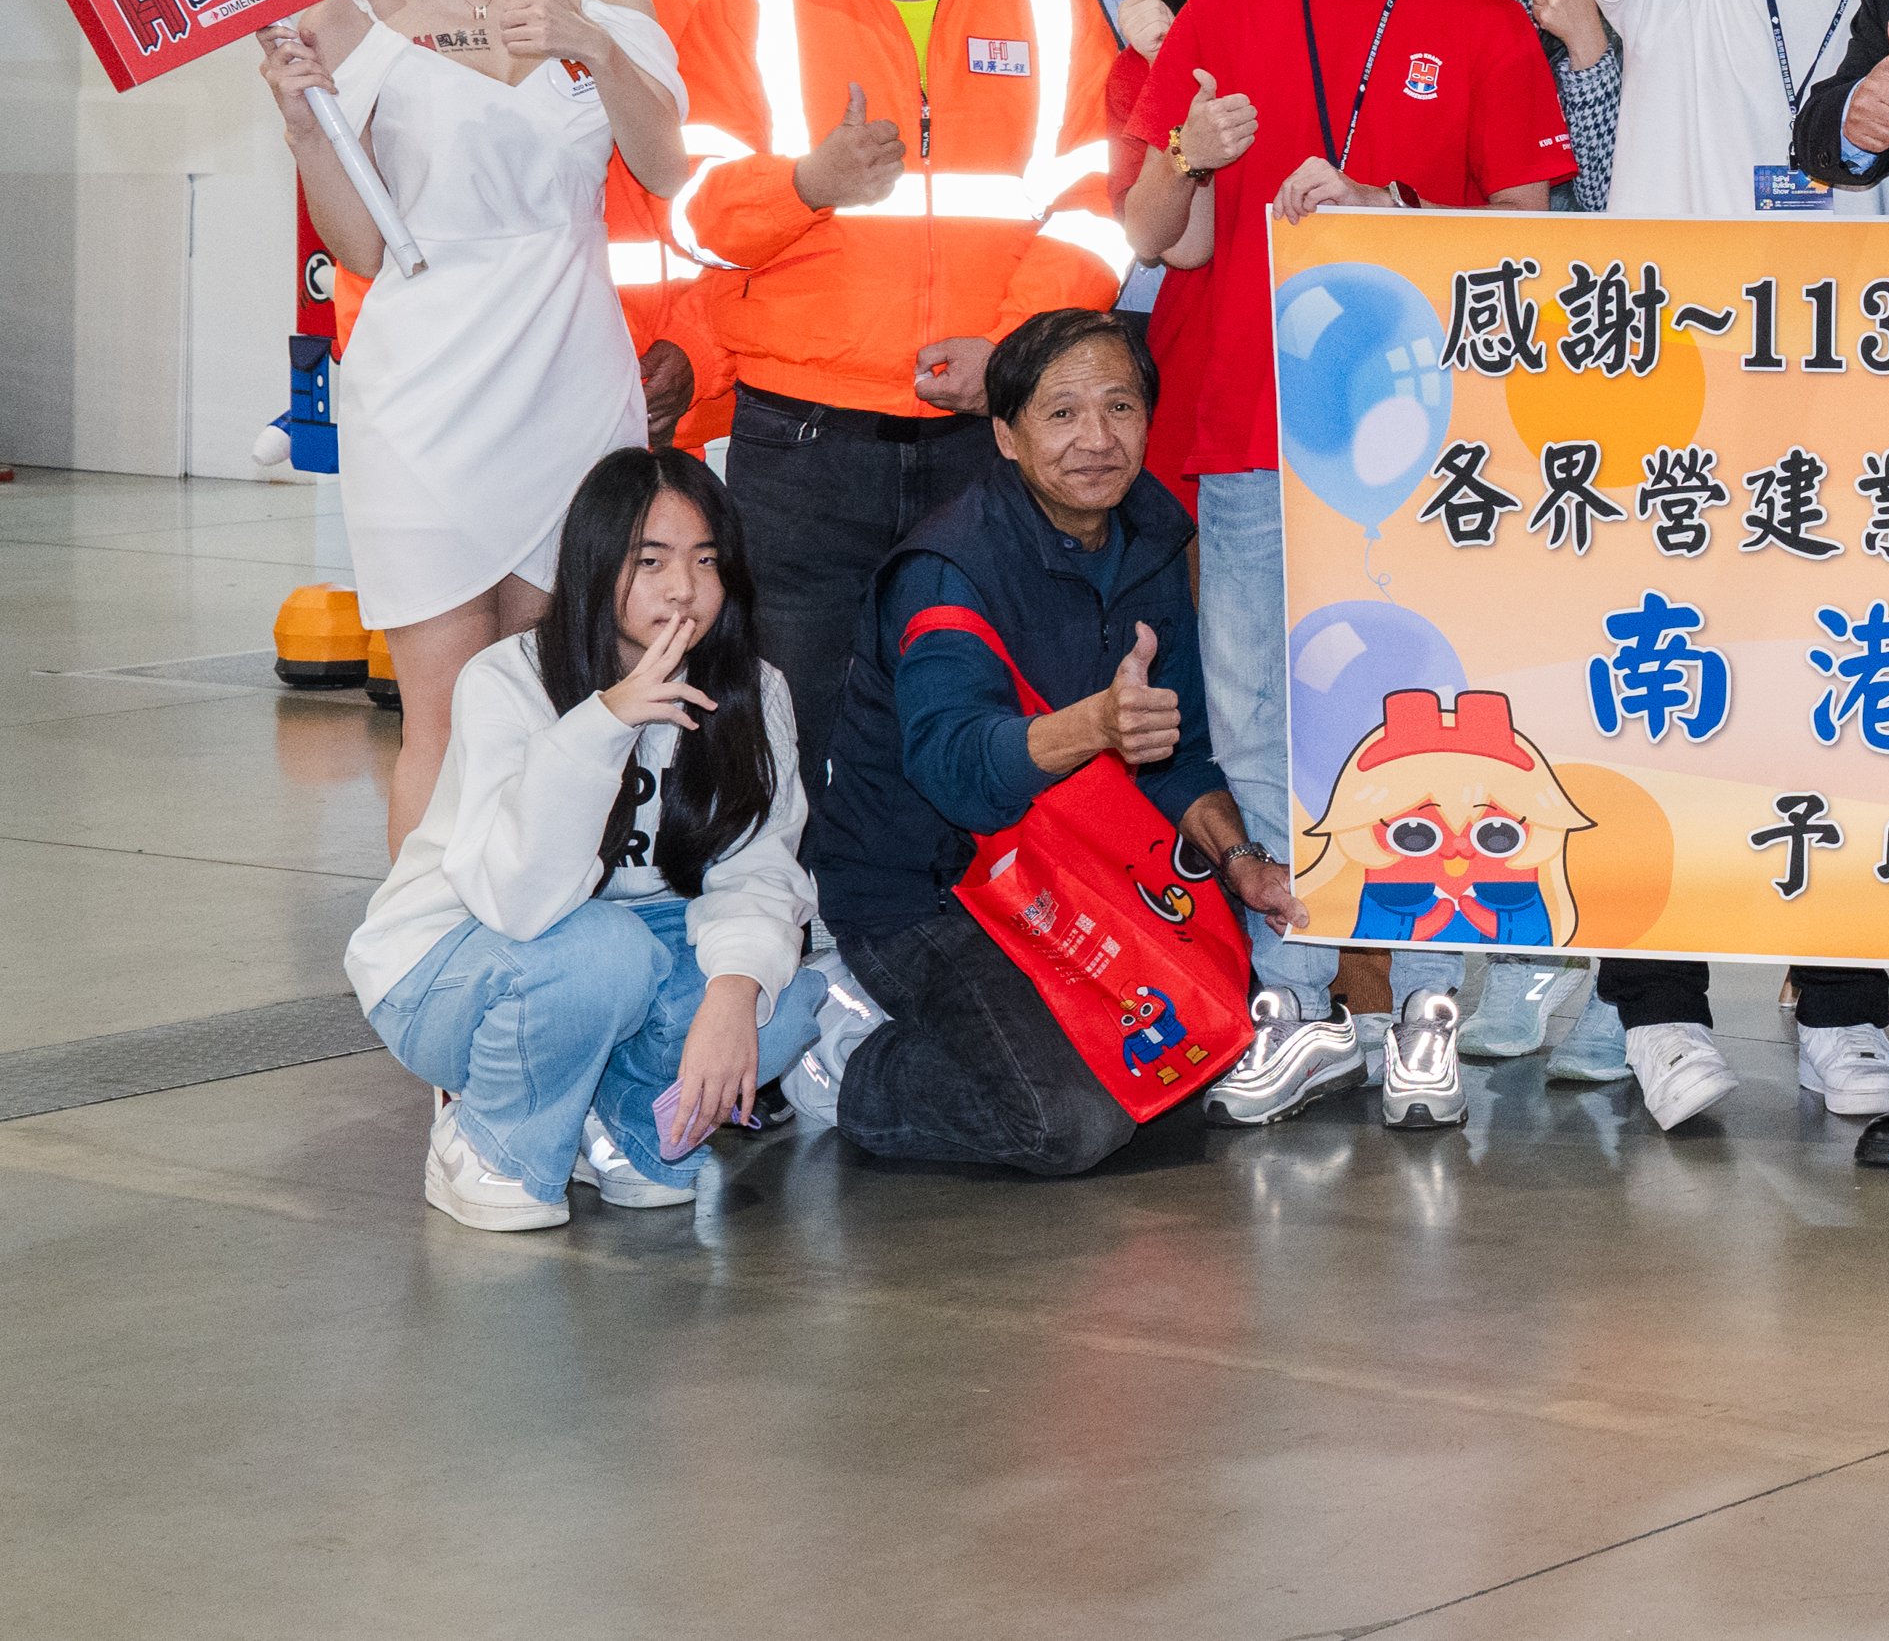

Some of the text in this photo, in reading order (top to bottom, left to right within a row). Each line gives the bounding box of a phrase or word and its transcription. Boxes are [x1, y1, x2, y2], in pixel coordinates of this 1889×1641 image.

[971, 59, 1027, 75] 國廣工程
[1772, 182, 1796, 190] Building
